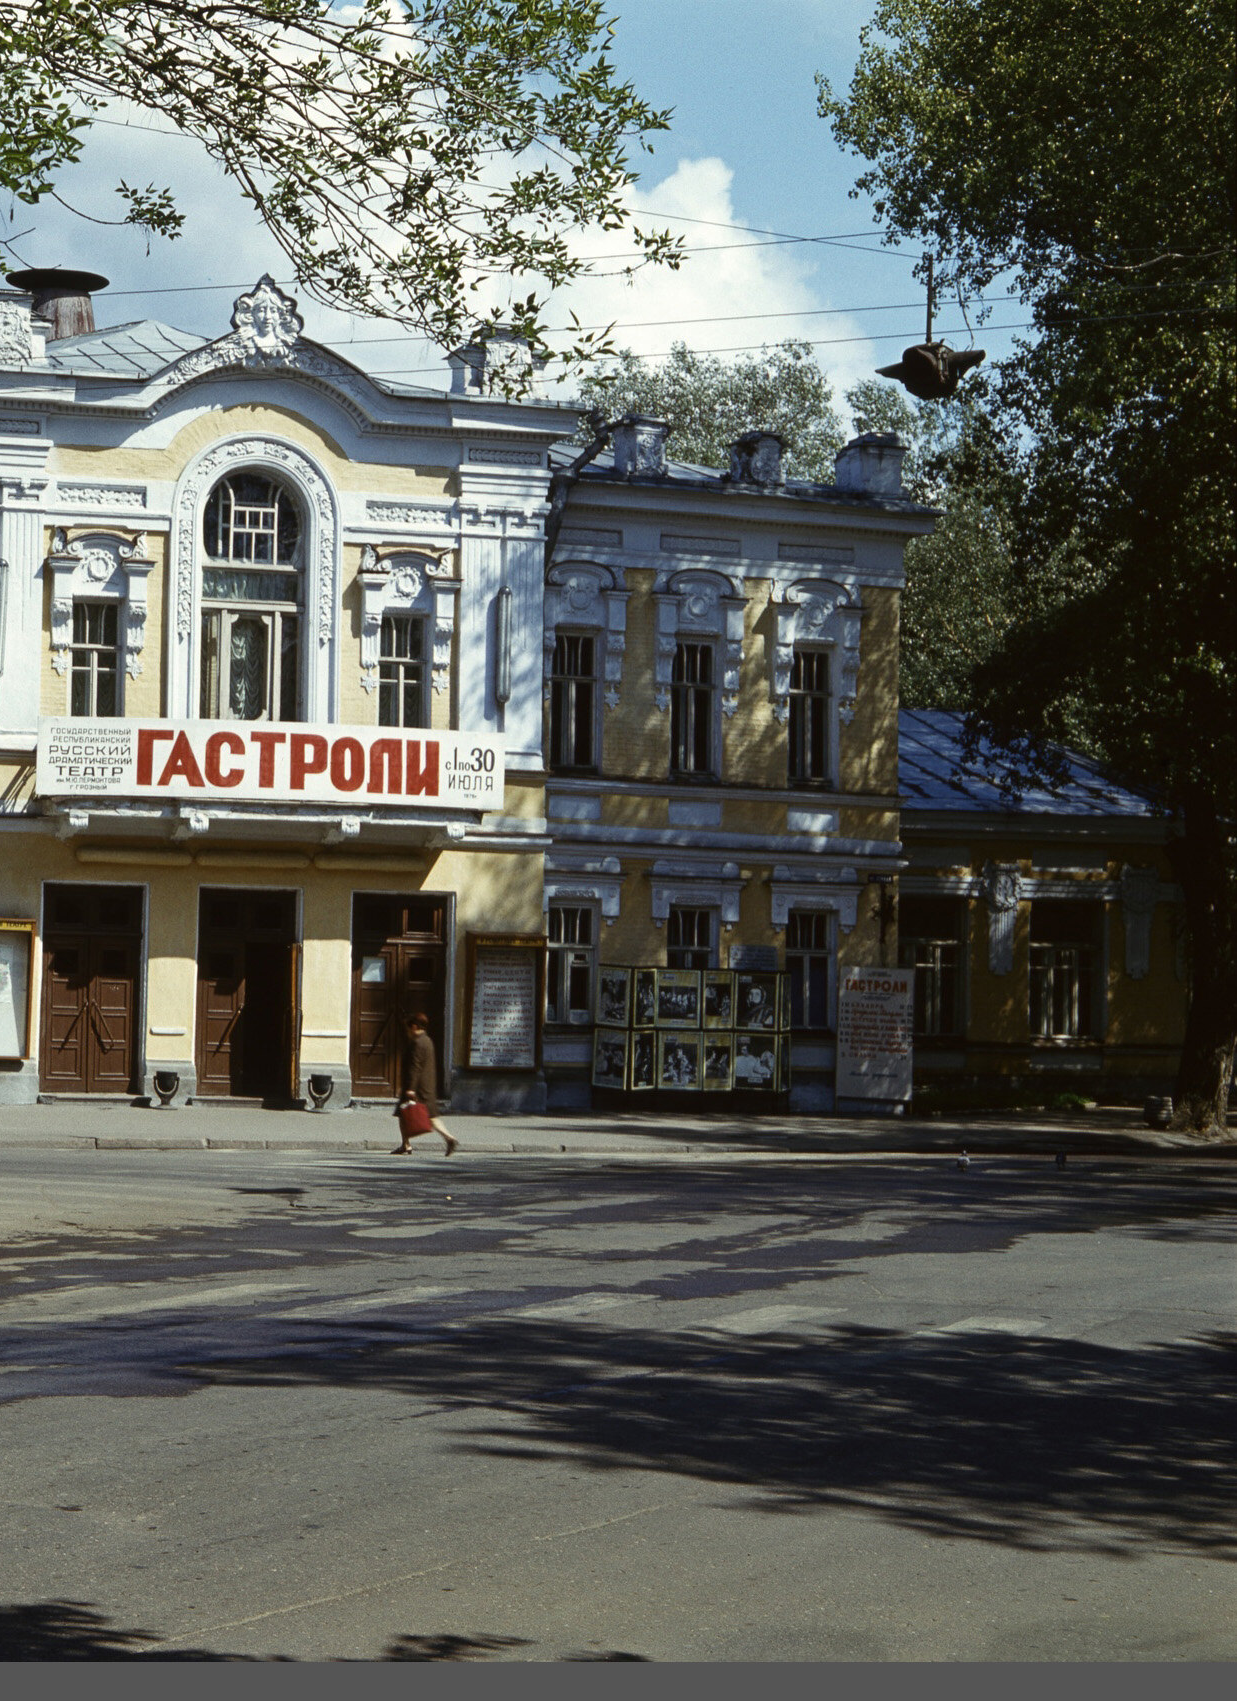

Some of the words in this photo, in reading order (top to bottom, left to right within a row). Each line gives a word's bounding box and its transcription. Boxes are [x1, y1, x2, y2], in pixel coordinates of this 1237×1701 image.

[50, 727, 132, 736] ГОСУДАРСТВЕННЫЙ
[52, 735, 131, 744] РЕСПУБЛИКАНСКИЙ
[48, 744, 132, 755] РУССКИЙ
[48, 756, 132, 765] ДРАМАТИЧЕСКИЙ
[136, 728, 440, 797] ГАСТРОЛИ
[459, 761, 471, 771] по
[471, 747, 495, 773] 30
[55, 765, 124, 777] ТЕАТР
[448, 774, 494, 791] ИЮЛЯ
[845, 978, 907, 993] ГАСТРОЛИ
